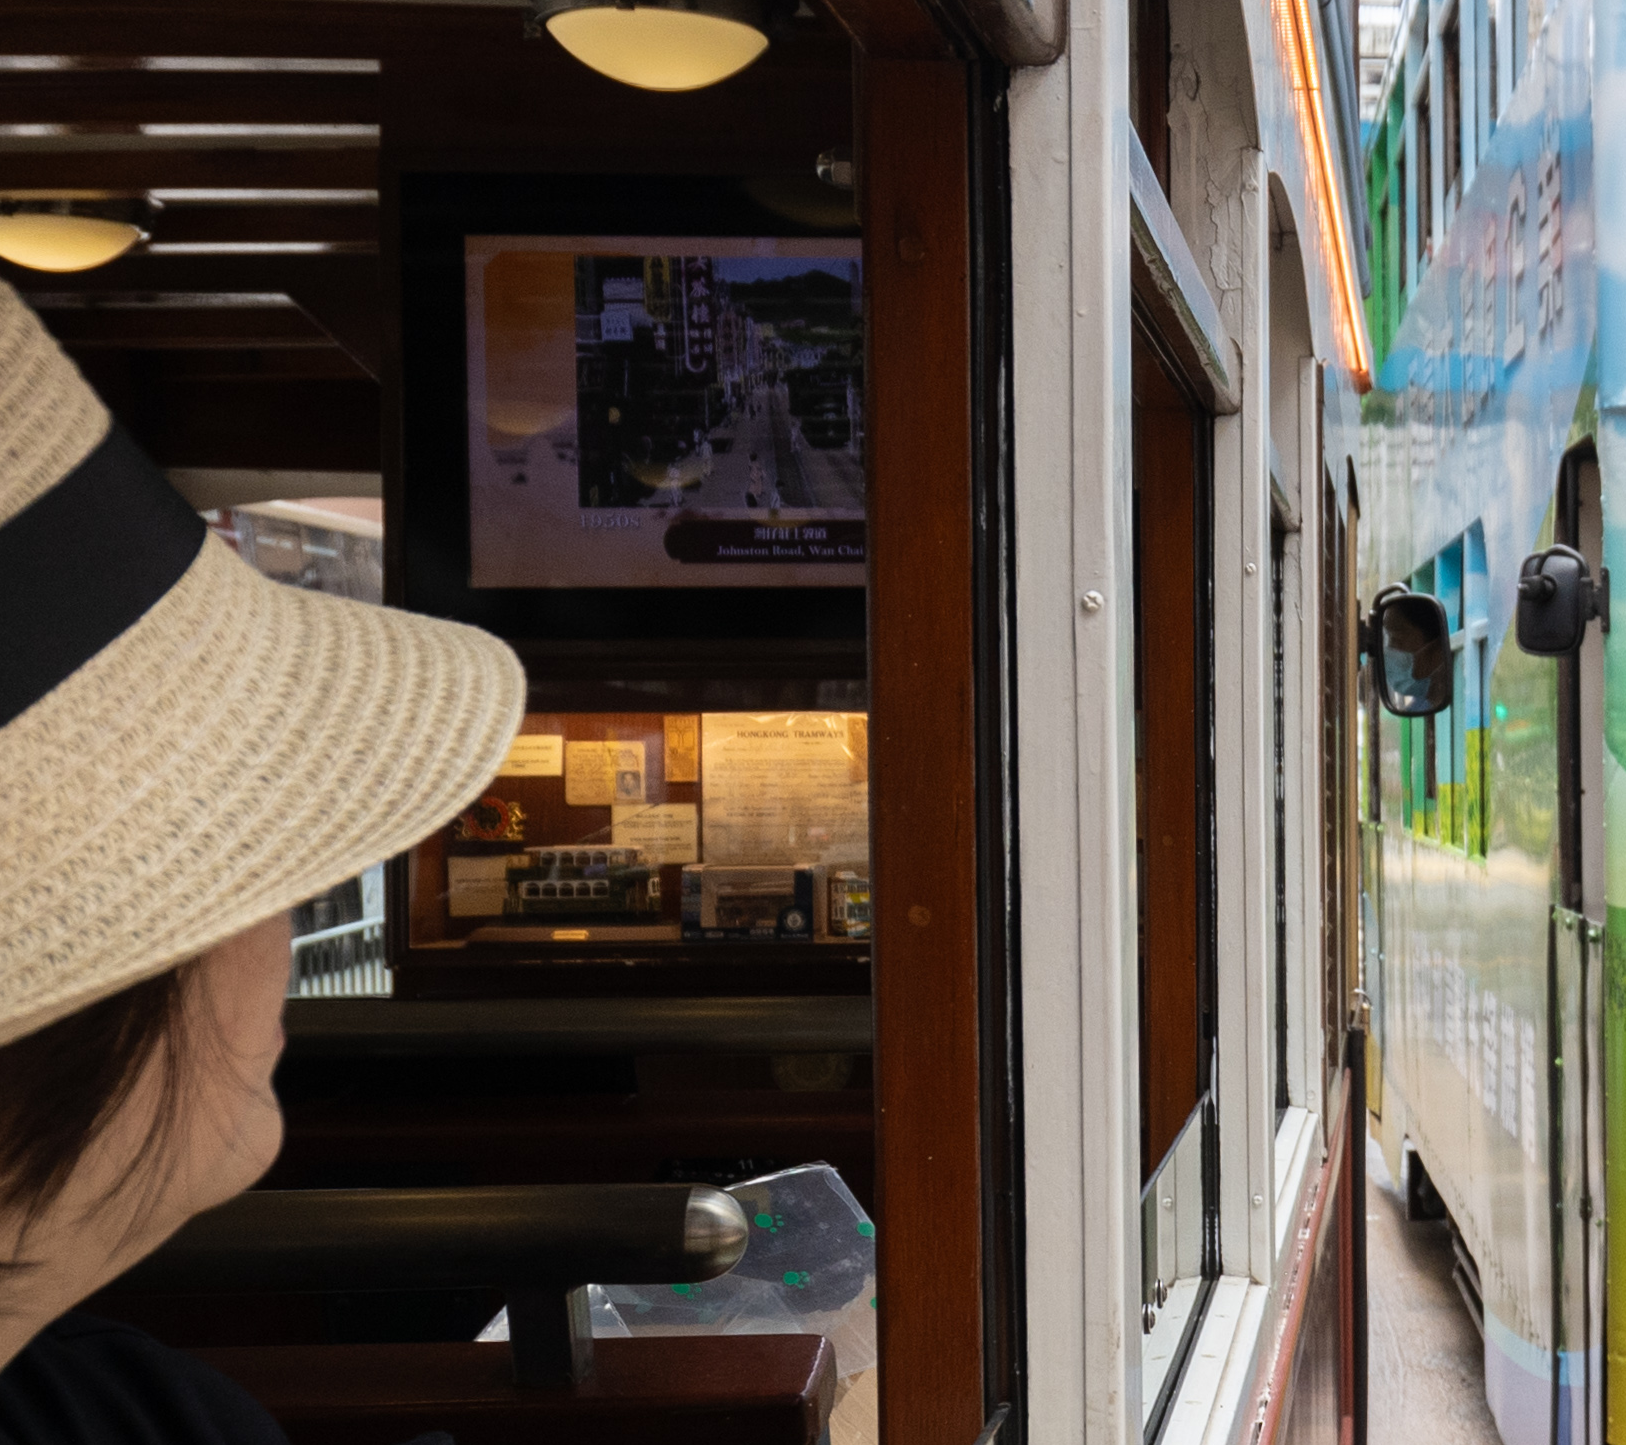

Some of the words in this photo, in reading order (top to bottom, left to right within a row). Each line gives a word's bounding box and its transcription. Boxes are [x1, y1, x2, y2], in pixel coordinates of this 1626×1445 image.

[578, 513, 642, 529] 1950s
[716, 544, 770, 557] Johnston
[771, 544, 805, 558] Road,
[808, 544, 837, 557] Wan
[837, 544, 865, 557] Chai
[736, 729, 789, 740] HONGKONG
[793, 729, 846, 740] TRAMWAYS
